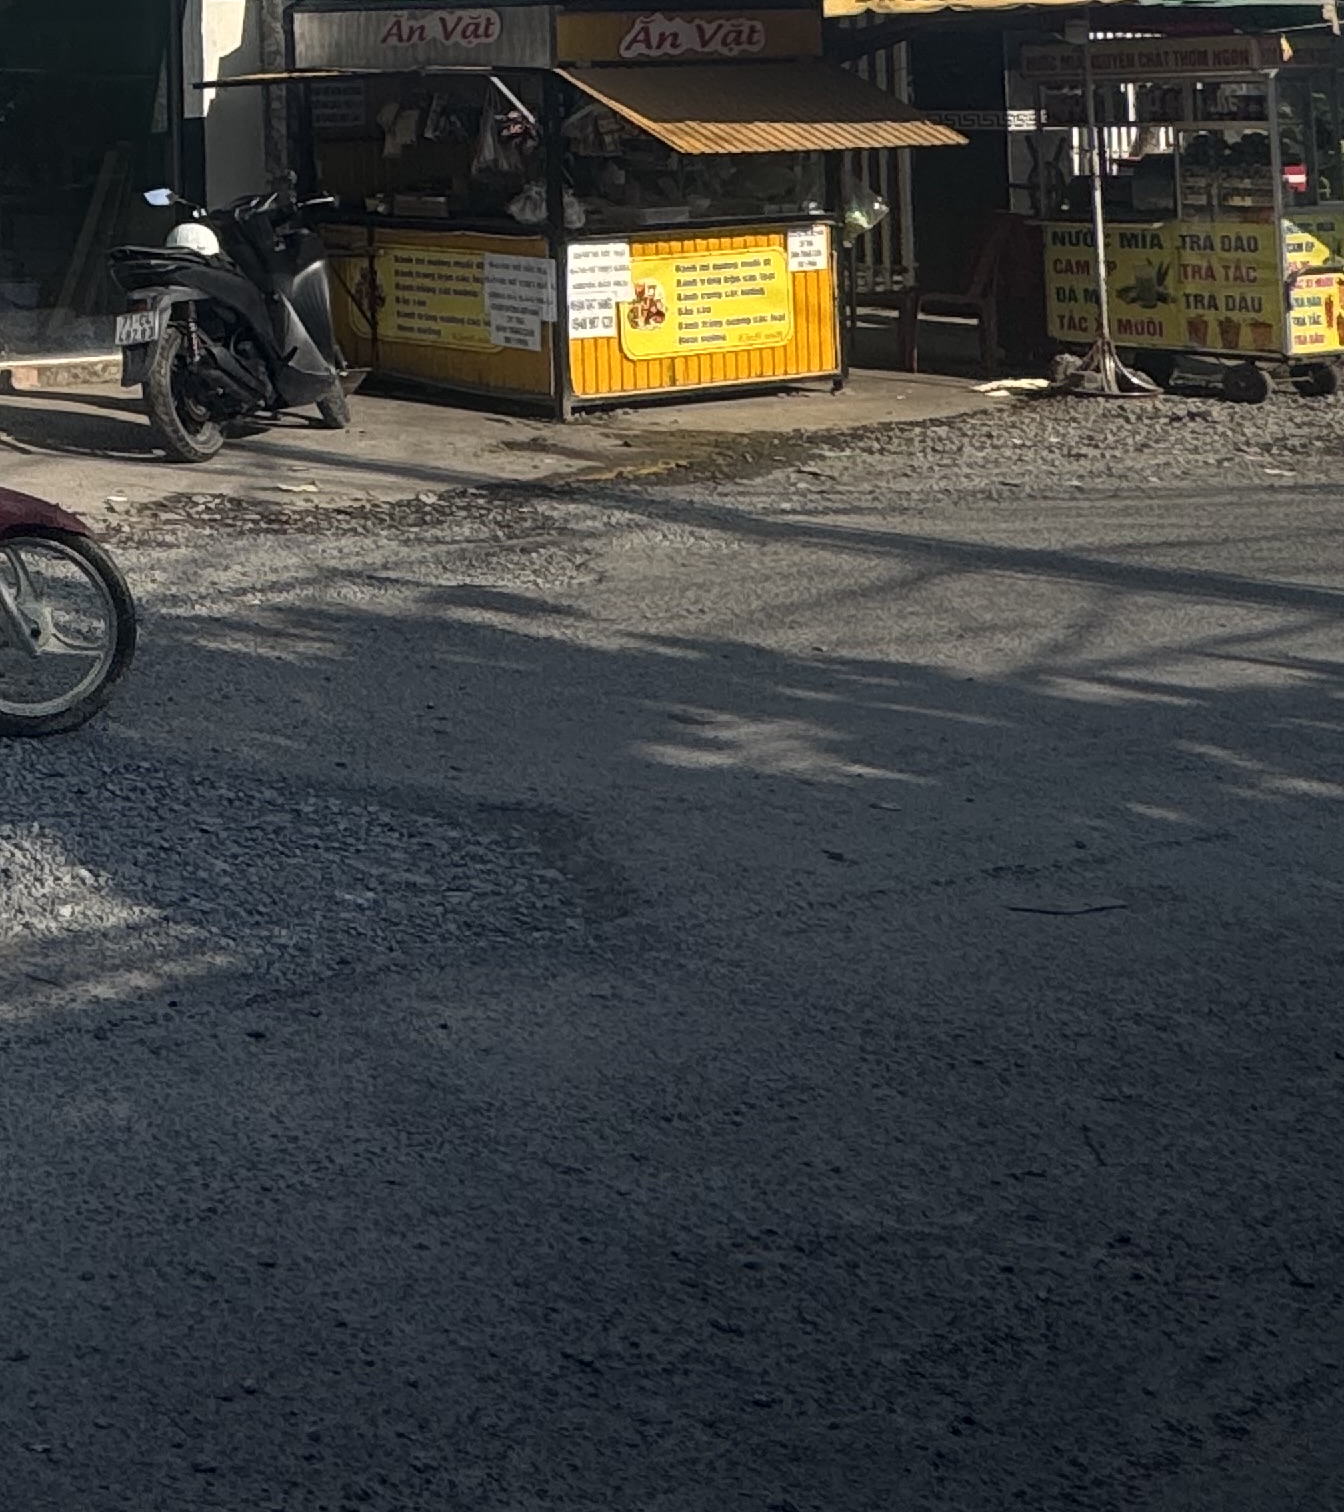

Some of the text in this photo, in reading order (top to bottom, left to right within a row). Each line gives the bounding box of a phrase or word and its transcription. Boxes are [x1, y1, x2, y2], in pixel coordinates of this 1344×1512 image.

[381, 13, 499, 46] Ăn Vặt
[625, 15, 763, 52] Ăn Vặt
[1053, 258, 1091, 276] CAM
